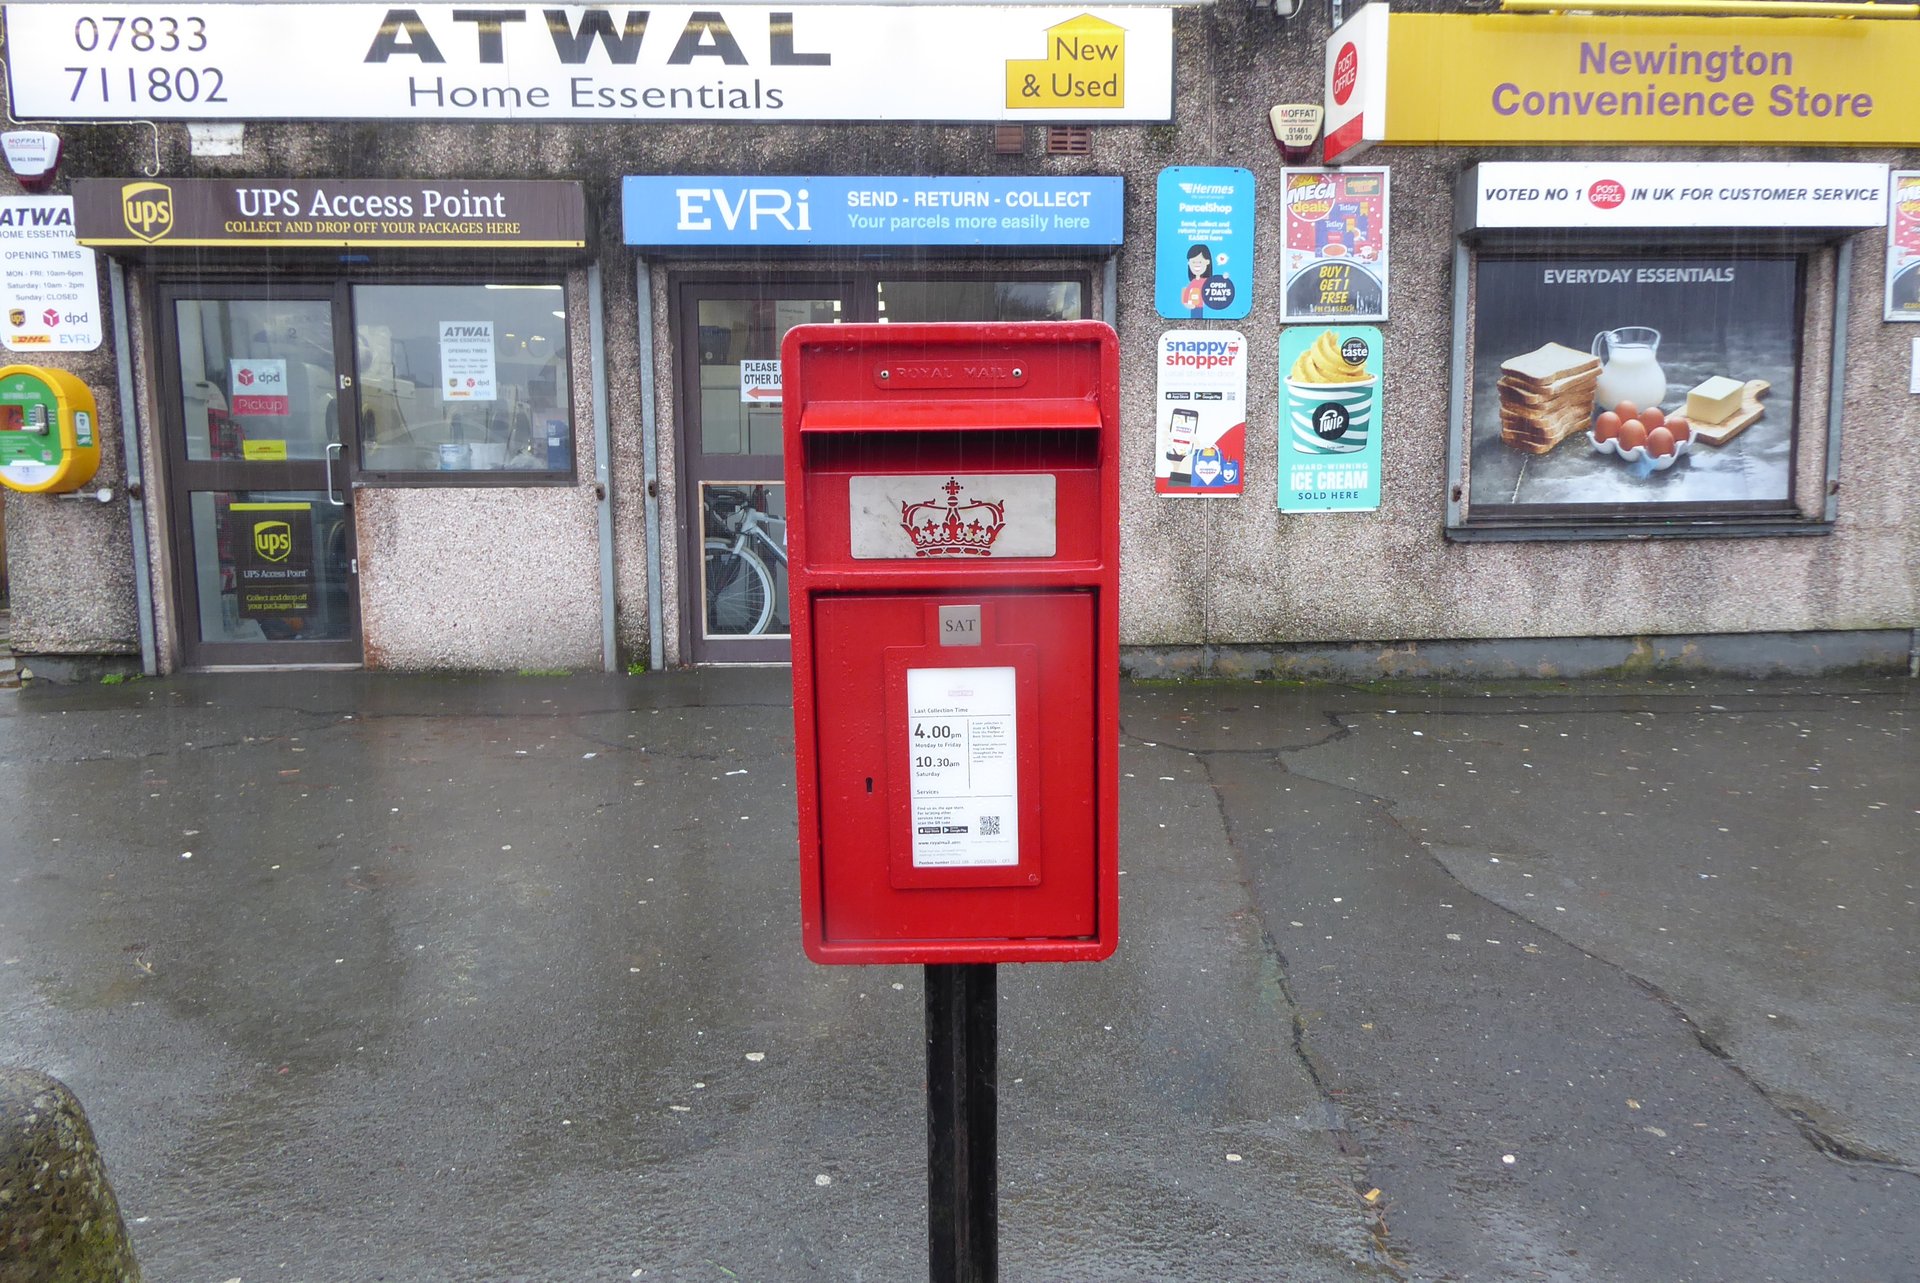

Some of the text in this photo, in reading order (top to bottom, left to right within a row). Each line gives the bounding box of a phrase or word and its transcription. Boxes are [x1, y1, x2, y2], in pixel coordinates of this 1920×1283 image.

[74, 16, 208, 52] 07833
[363, 9, 831, 66] ATWAL
[1056, 36, 1119, 61] New
[1337, 51, 1354, 76] POST
[1579, 41, 1793, 82] Newington
[65, 67, 228, 103] 711802
[1021, 73, 1118, 98] & Used
[1334, 69, 1355, 94] OFFICE
[408, 76, 784, 110] Home Essentials
[1492, 82, 1874, 117] Convenience Store
[1281, 110, 1315, 118] MOFFAT
[1192, 184, 1234, 194] Hermes
[1287, 183, 1336, 205] MEGA
[1485, 188, 1582, 201] VOTED NO 1
[1595, 185, 1619, 194] POST
[1631, 188, 1879, 201] IN UK FOR CUSTOMER SERVICE
[236, 189, 506, 218] UPS Access Point
[847, 191, 898, 207] SEND
[914, 191, 989, 207] RETURN
[1005, 191, 1091, 207] COLLECT
[1590, 194, 1623, 204] OFFICE
[125, 199, 169, 229] ups
[675, 188, 811, 231] EVRi
[1179, 202, 1232, 215] ParcelShop
[1292, 202, 1329, 213] deals
[1339, 204, 1358, 213] Tetley
[0, 207, 73, 226] ATWA
[847, 213, 1090, 231] Your parcels more easily here
[225, 221, 521, 235] COLLECT AND DROP OFF YOUR PACKAGES HERE
[1325, 220, 1344, 229] Tetley
[27, 230, 76, 239] ESSENTIA
[5, 250, 82, 260] OPENING TIMES
[1319, 266, 1342, 278] BUY
[1543, 268, 1735, 284] EVERYDAY ESSENTIALS
[69, 282, 84, 290] 2pm
[1319, 279, 1342, 291] GET
[1320, 291, 1349, 304] FREE
[64, 312, 88, 325] dpd
[444, 326, 490, 336] ATWAL
[60, 334, 91, 344] EVRi
[1166, 341, 1227, 355] snappy
[1342, 347, 1368, 357] taste
[745, 362, 777, 372] PLEASE
[1166, 353, 1235, 369] shopper
[258, 372, 281, 384] dpd
[896, 366, 1007, 378] ROYAL MAIL
[744, 374, 782, 384] OTHER DO
[239, 398, 283, 412] Pickup
[1291, 463, 1368, 471] AWARD-WINNING
[1291, 471, 1368, 491] ICE CREAM
[1298, 491, 1359, 500] SOLD HERE
[257, 533, 288, 555] ups
[243, 570, 260, 578] UPS
[944, 619, 977, 632] SAT
[914, 722, 961, 738] 4.00pm
[916, 756, 960, 767] 10.30am
